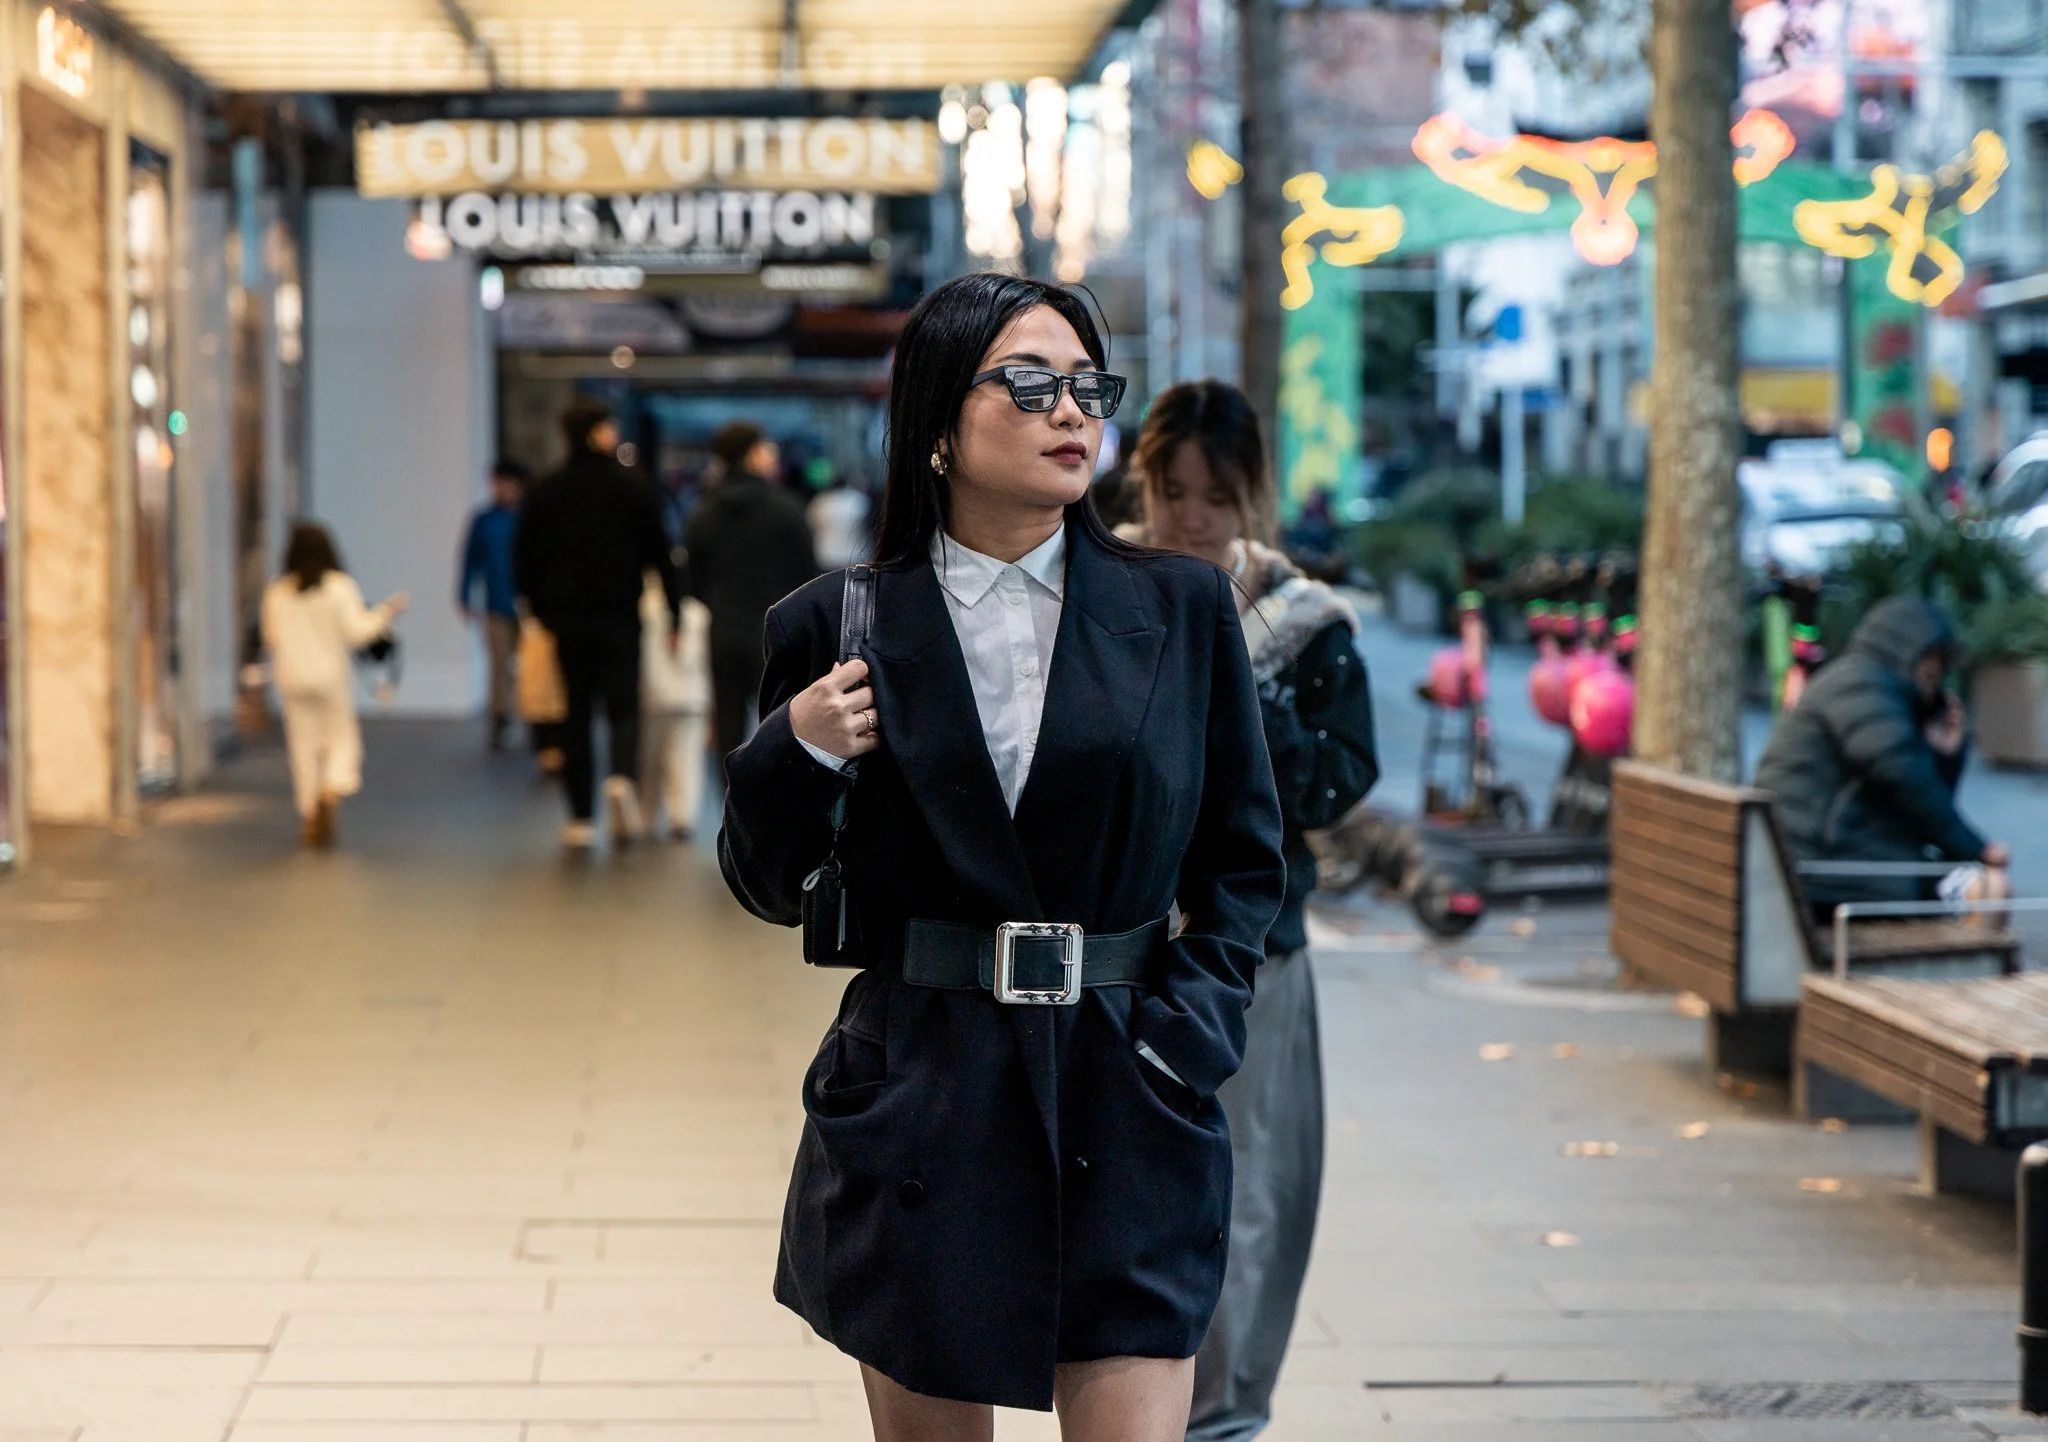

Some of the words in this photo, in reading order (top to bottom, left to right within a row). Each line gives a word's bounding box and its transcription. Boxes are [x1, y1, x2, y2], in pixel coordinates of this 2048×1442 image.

[372, 119, 588, 183] LOUIS
[607, 117, 925, 183] VUITTON
[419, 191, 600, 250] LOUIS
[609, 191, 874, 249] VUITTON
